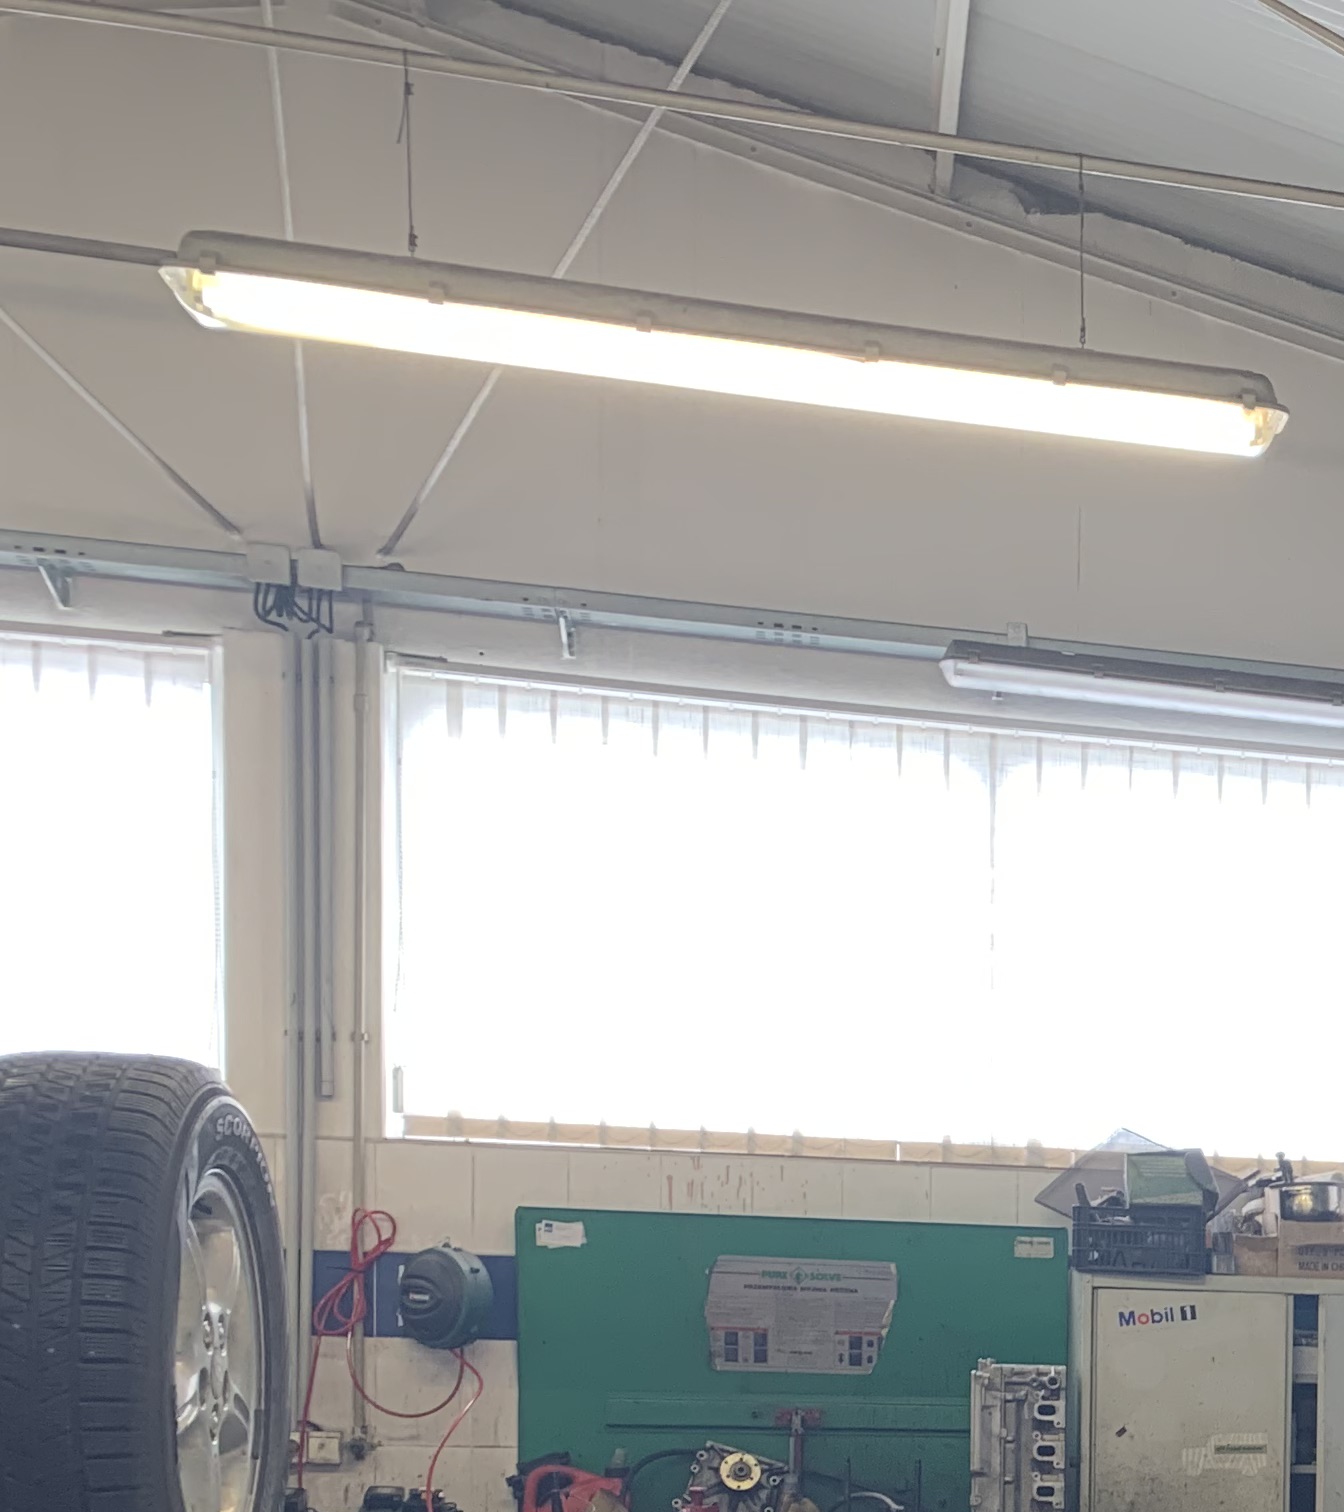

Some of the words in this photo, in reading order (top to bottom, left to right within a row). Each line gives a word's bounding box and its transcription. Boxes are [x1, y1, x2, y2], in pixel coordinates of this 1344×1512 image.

[1298, 1262, 1320, 1272] MADE
[1321, 1262, 1329, 1272] IN
[1118, 1307, 1174, 1328] Mobil
[1180, 1304, 1197, 1321] 1
